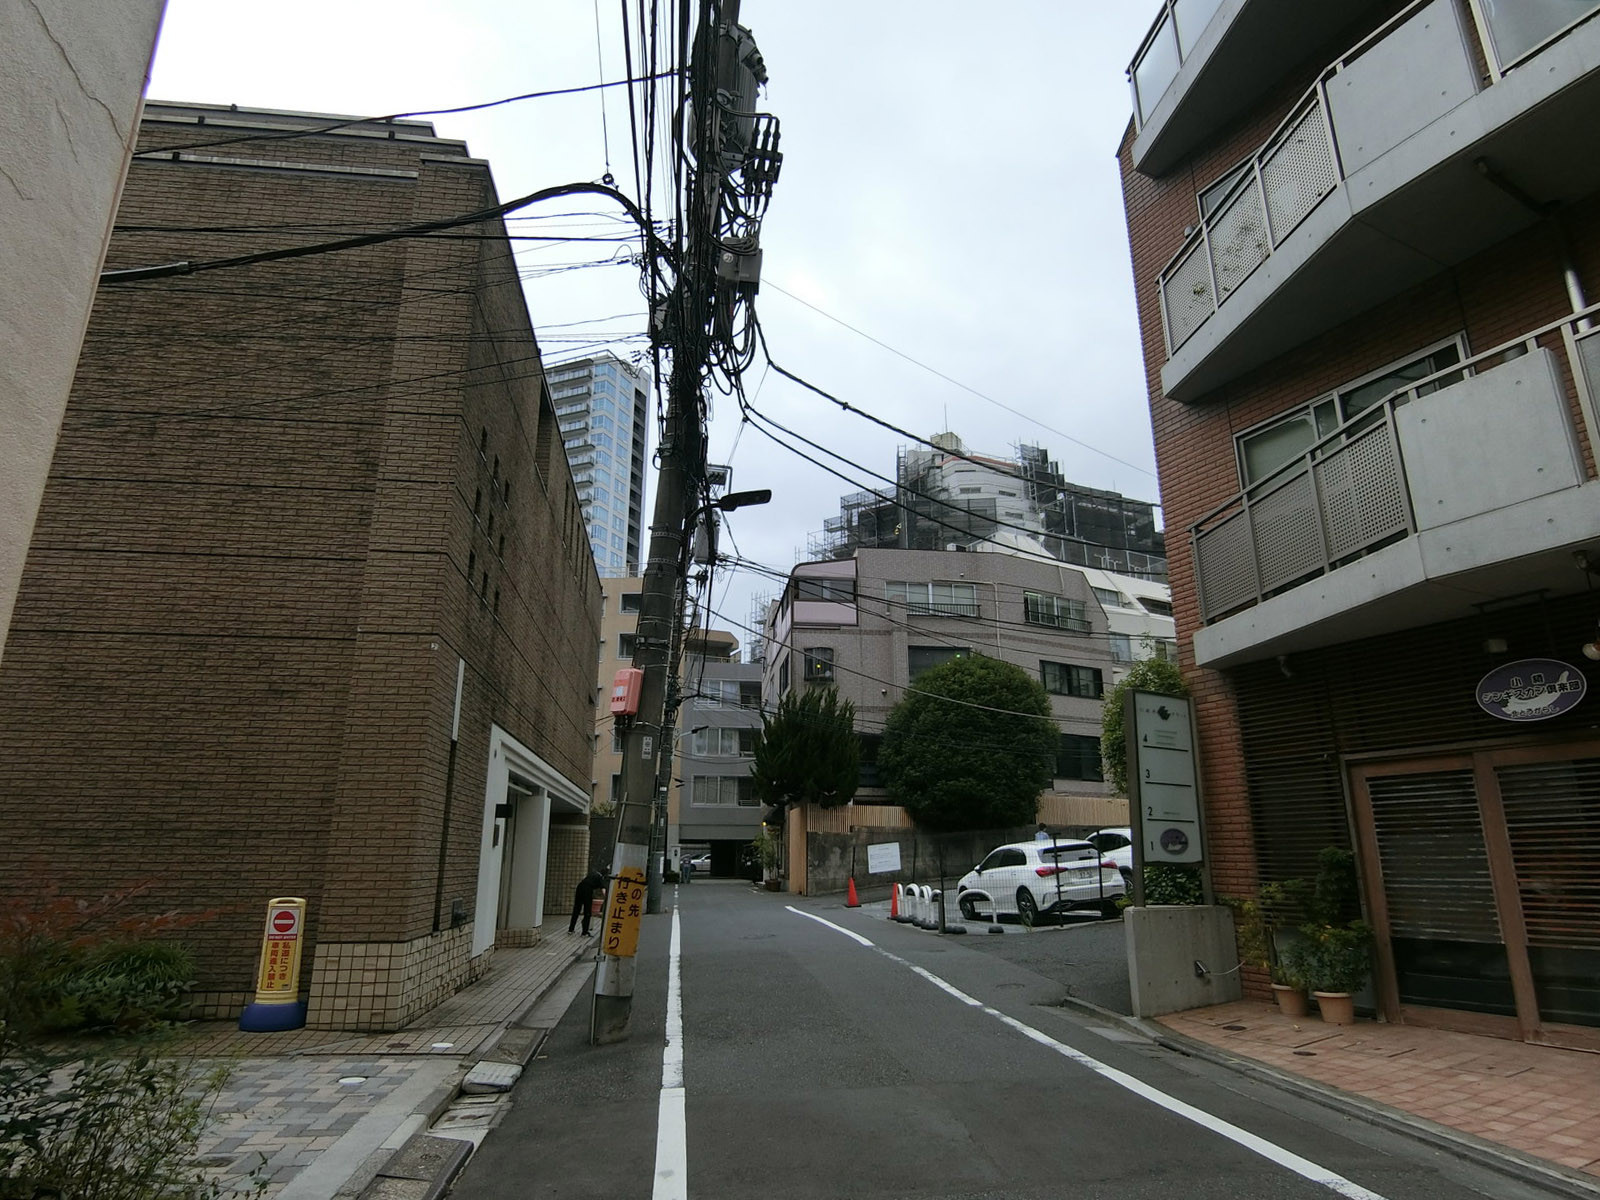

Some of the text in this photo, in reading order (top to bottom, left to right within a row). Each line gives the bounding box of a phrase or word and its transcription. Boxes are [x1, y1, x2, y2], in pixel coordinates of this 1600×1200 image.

[1143, 734, 1148, 743] 4
[1145, 769, 1150, 779] 3
[1147, 806, 1153, 816] 2
[608, 876, 630, 950] 行き止まり
[628, 872, 644, 918] この先
[266, 942, 280, 989] 車両進入禁止
[279, 942, 291, 980] 私道につき
